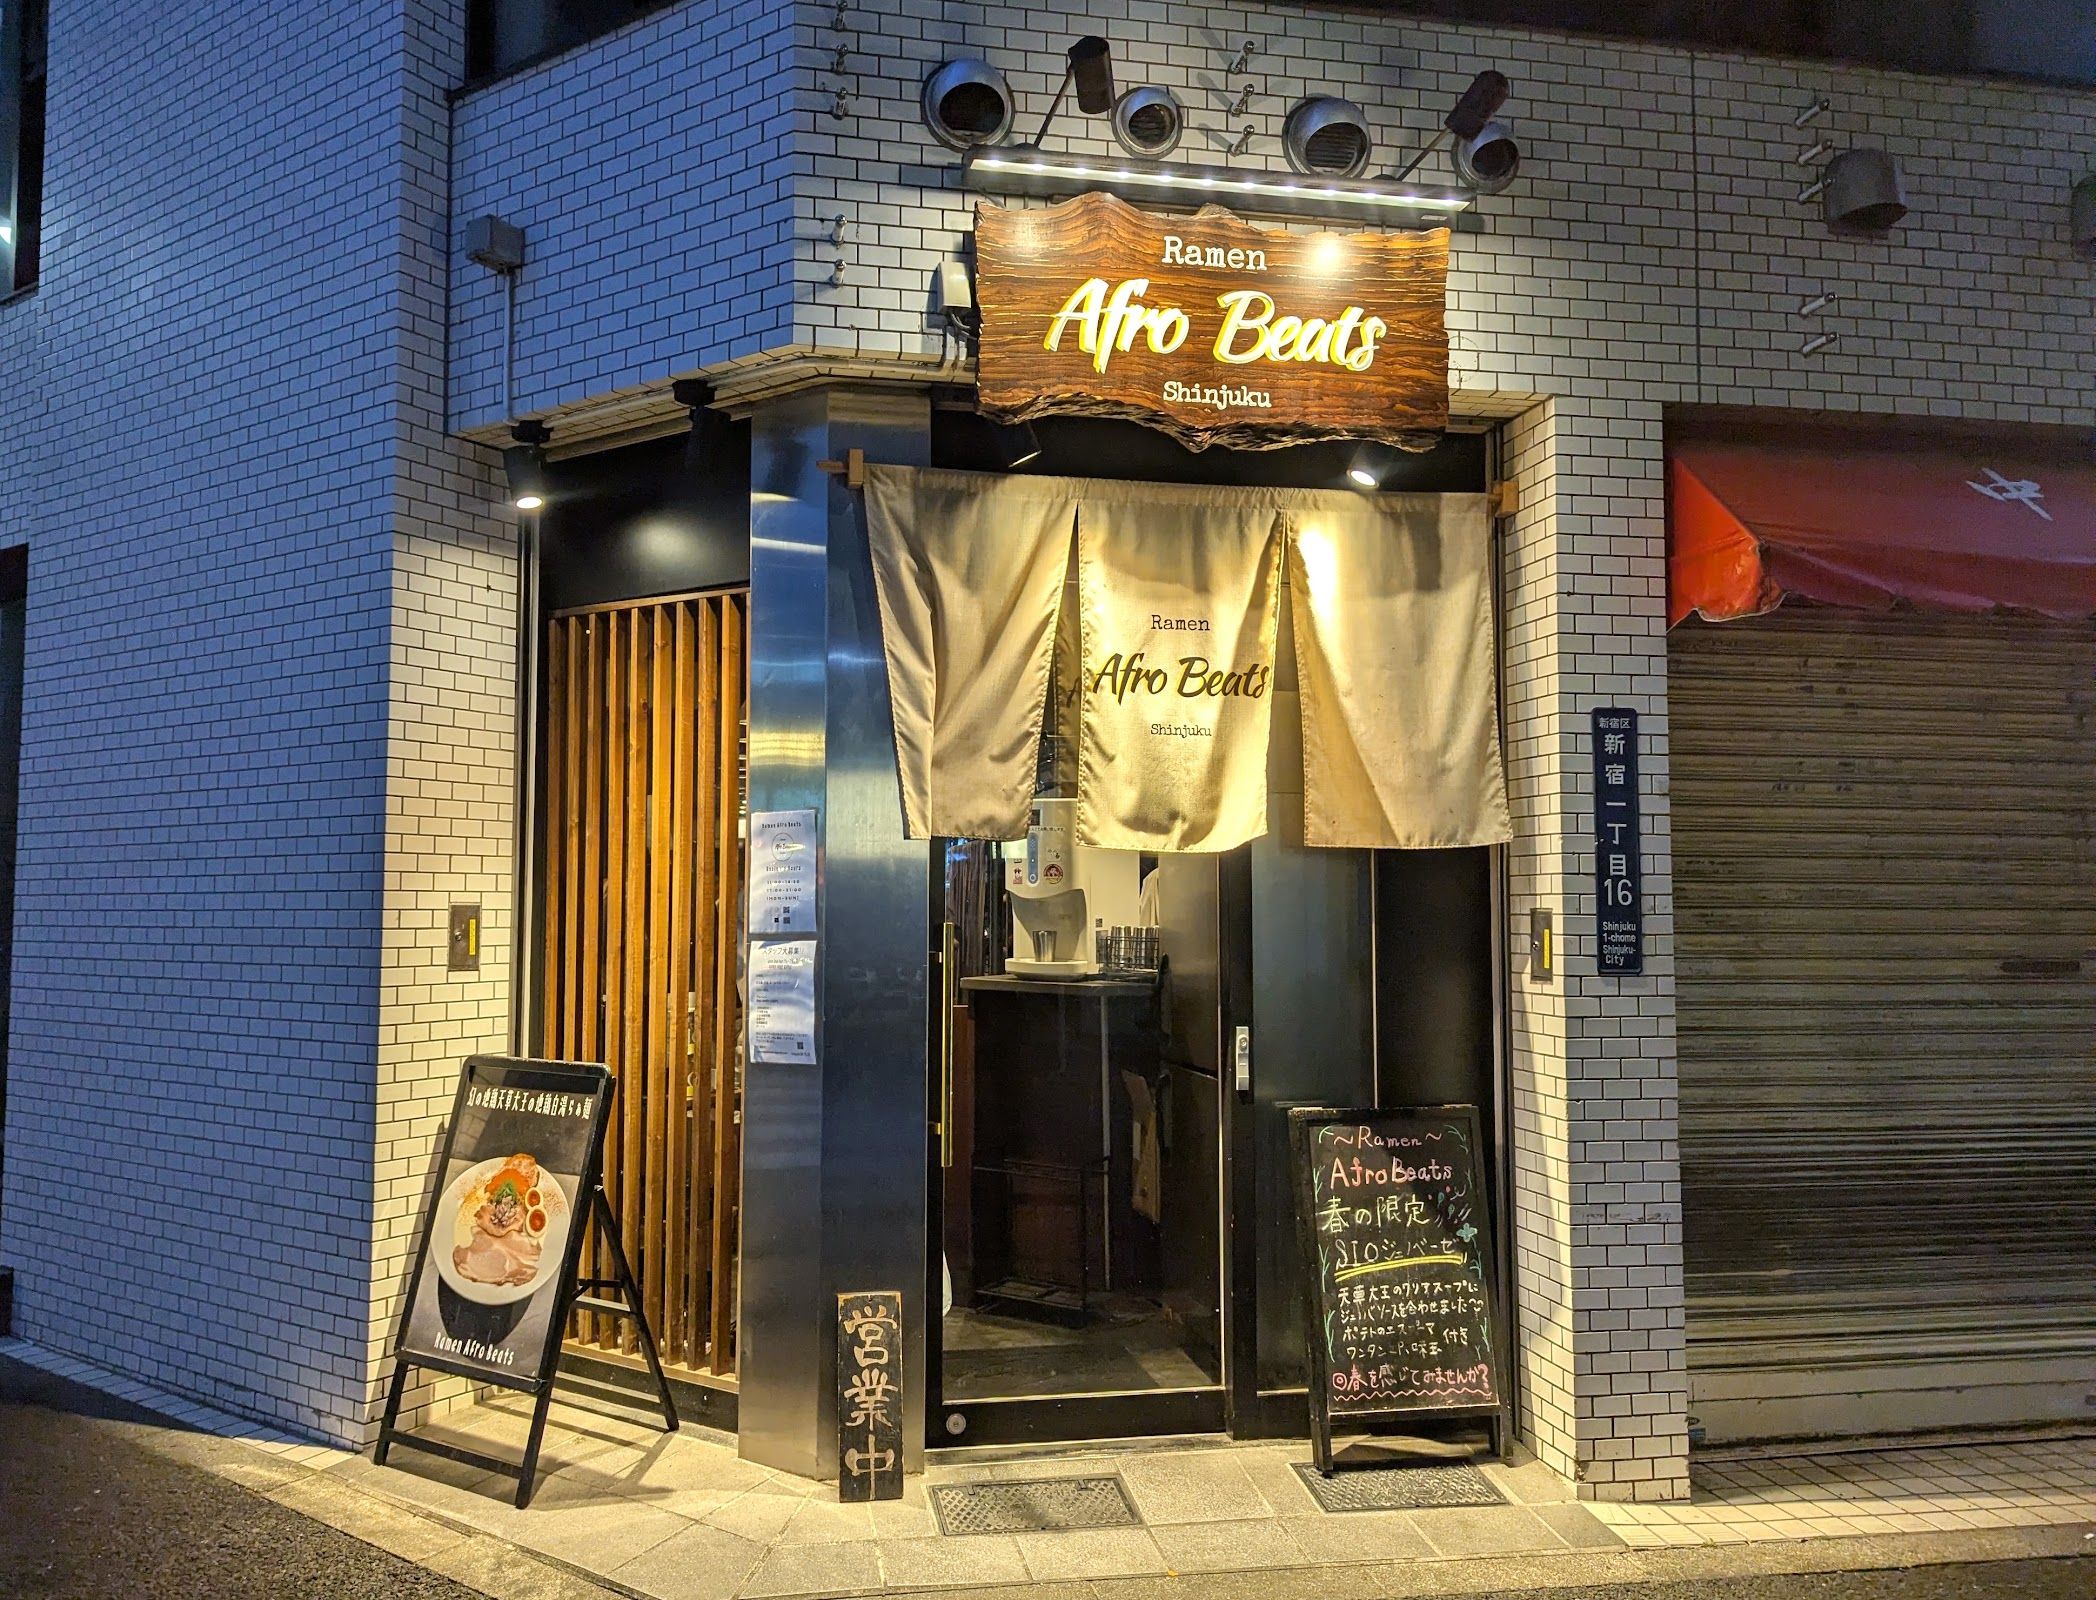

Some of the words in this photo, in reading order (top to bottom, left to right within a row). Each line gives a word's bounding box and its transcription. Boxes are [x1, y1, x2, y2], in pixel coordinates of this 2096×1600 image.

[1161, 235, 1267, 272] Ramen
[1043, 277, 1189, 375] Afro
[1212, 290, 1387, 372] Beats
[1162, 381, 1272, 409] Shinjuku
[1151, 614, 1211, 631] Ramen
[1092, 653, 1168, 706] Afro
[1177, 657, 1270, 699] Beats
[1150, 724, 1212, 739] Shinjuku
[1599, 717, 1631, 729] 新宿区
[1604, 733, 1627, 877] 新宿一丁目
[1604, 879, 1633, 906] 16
[1602, 921, 1636, 932] Shinjuku
[1602, 932, 1636, 943] 1-chome
[1602, 944, 1636, 955] Shinjuku-
[1605, 954, 1624, 966] City
[1318, 1195, 1430, 1233] 春の限定
[434, 1332, 462, 1354] Ramen
[462, 1338, 484, 1359] Afro
[486, 1343, 514, 1365] Beats
[843, 1305, 899, 1500] 営業中
